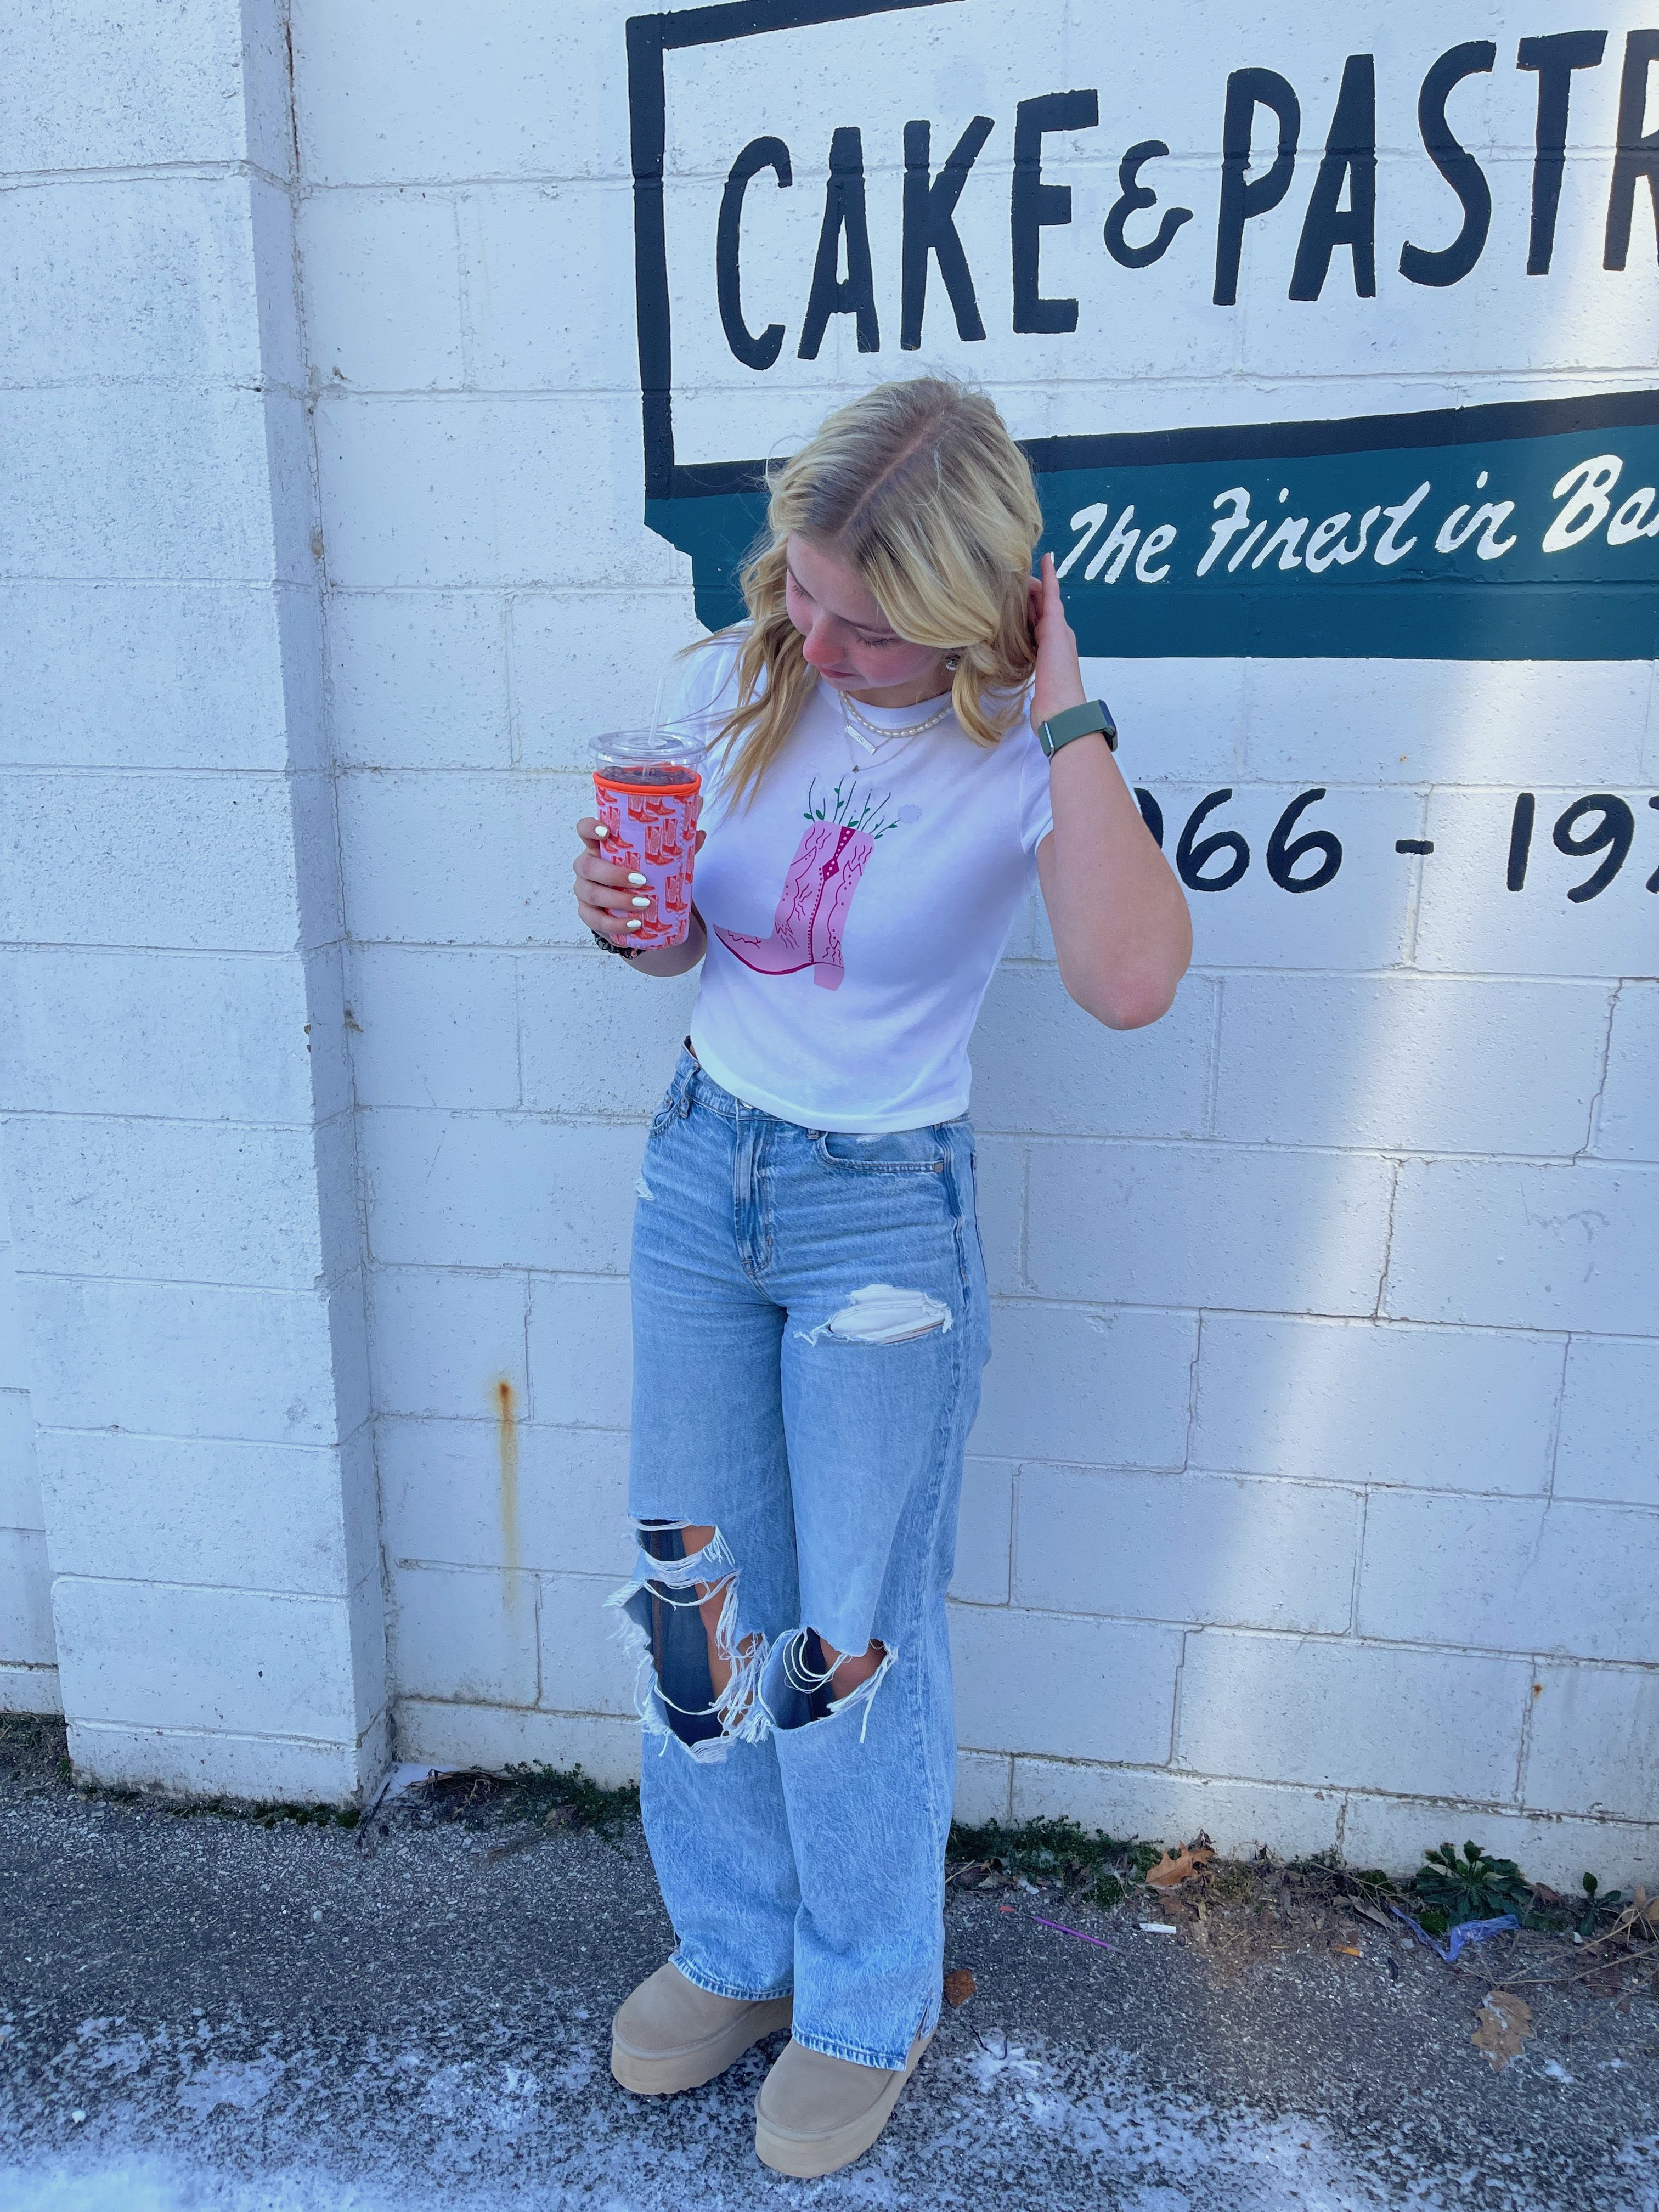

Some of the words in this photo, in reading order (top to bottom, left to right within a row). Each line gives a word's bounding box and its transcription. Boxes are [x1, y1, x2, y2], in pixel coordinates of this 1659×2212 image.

[716, 89, 1099, 371] CAKE
[1103, 140, 1194, 269] &
[1212, 29, 1659, 307] PASTR
[1055, 502, 1177, 585] The
[1195, 480, 1431, 574] Finest
[1434, 470, 1518, 561] in
[1395, 839, 1435, 856] -
[1506, 792, 1659, 904] 19
